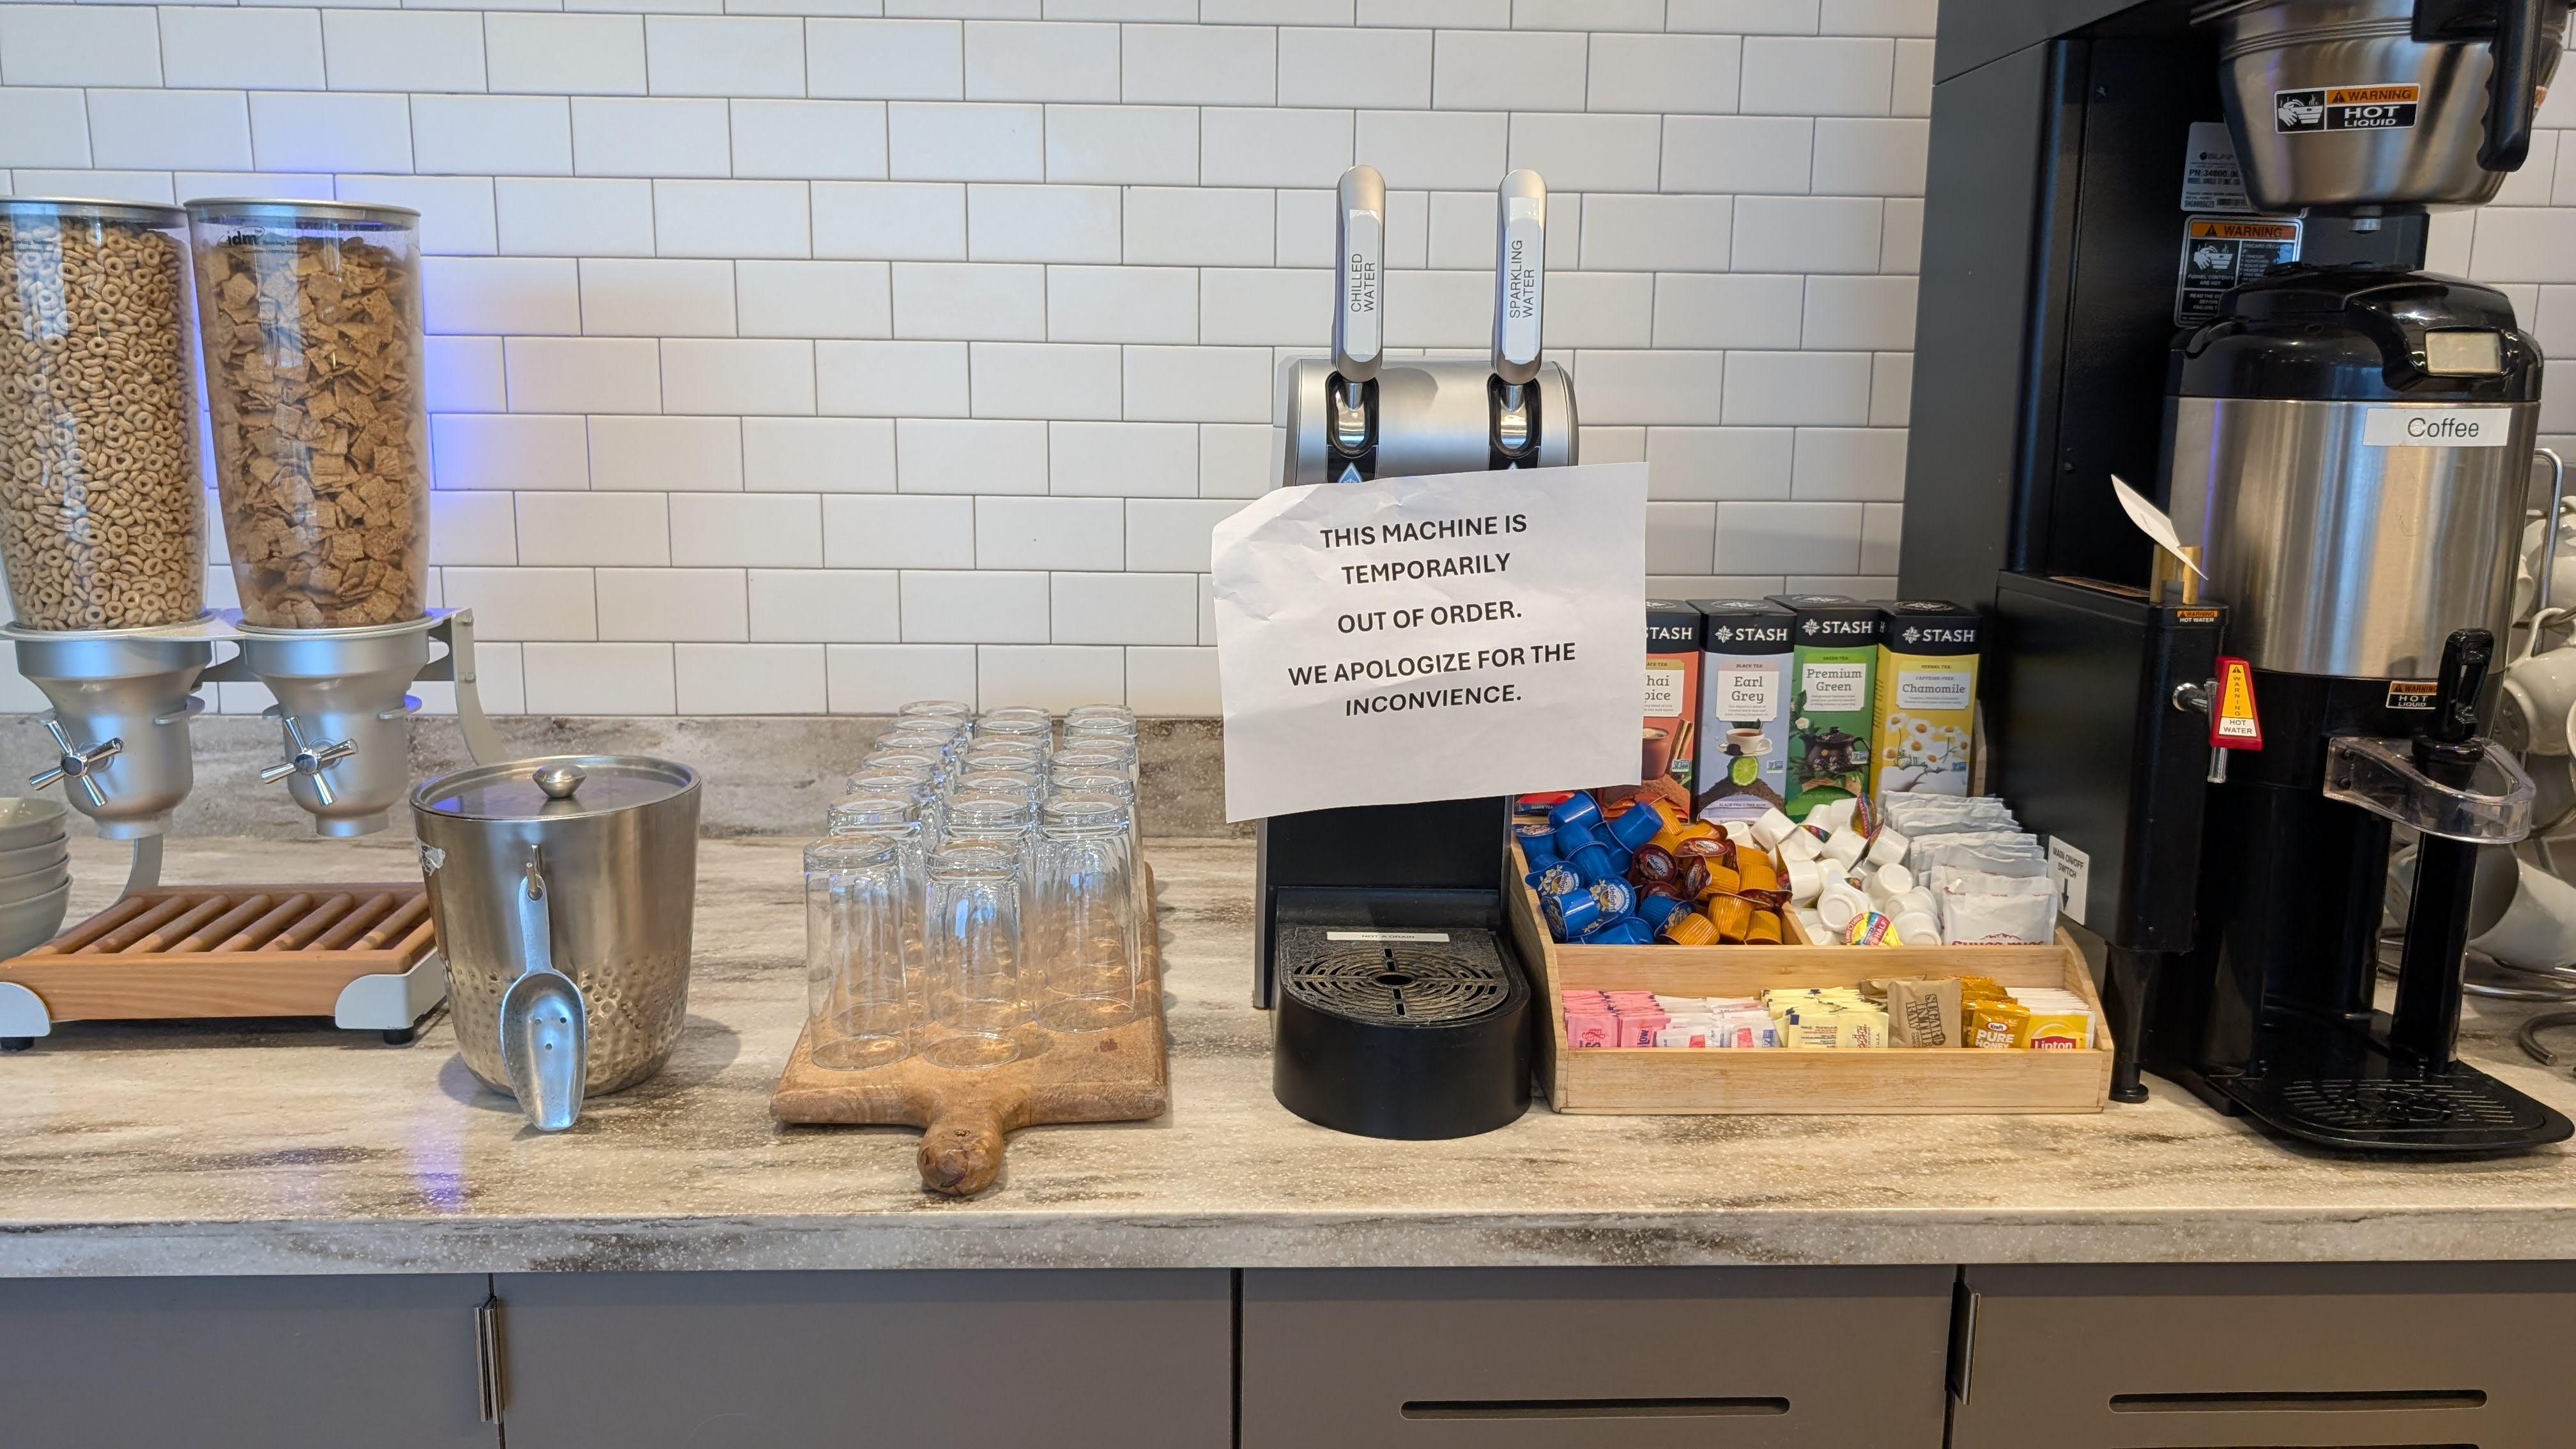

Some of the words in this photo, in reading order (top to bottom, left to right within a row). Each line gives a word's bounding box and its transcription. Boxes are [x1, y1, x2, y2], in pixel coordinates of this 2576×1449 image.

[2348, 89, 2412, 102] WARNING
[2344, 106, 2400, 119] HOT
[2344, 118, 2396, 127] LIQUID
[2224, 225, 2283, 238] WARNING
[1351, 253, 1363, 312] CHILLED
[1509, 240, 1523, 318] SPARKLING
[1363, 263, 1376, 312] WATER
[1522, 269, 1535, 318] WATER
[2407, 417, 2480, 438] Coffee
[1320, 525, 1376, 549] THIS
[1383, 516, 1498, 544] MACHINE
[1505, 514, 1528, 533] IS
[1342, 553, 1510, 585] TEMPORARILY
[1337, 611, 1386, 634] OUT
[1393, 609, 1424, 629] OF
[1430, 601, 1522, 626] ORDER.
[1735, 628, 1788, 641] STASH
[1821, 621, 1872, 634] STASH
[1922, 629, 1975, 642] STASH
[1288, 665, 1328, 687] WE
[1333, 652, 1471, 683] APOLOGIZE
[1478, 646, 1526, 669] FOR
[1531, 643, 1576, 664] THE
[1646, 675, 1670, 686] hai
[1806, 668, 1862, 678] Premium
[1733, 676, 1763, 687] Earl
[1816, 681, 1851, 691] Green
[1902, 683, 1965, 693] Chamomile
[2405, 684, 2438, 693] WARNING
[1345, 684, 1522, 716] INCONVIENCE.
[1731, 690, 1764, 704] Grey
[2232, 676, 2242, 716] WARNING
[2223, 726, 2253, 735] WATER
[1646, 854, 1667, 876] delight
[2053, 847, 2065, 861] MAIN
[2065, 854, 2084, 870] ON/OFF
[2057, 862, 2077, 879] SWITCH
[1873, 919, 1889, 939] HALF
[1906, 1001, 1919, 1029] RAW
[1916, 1003, 1928, 1018] IN
[1925, 994, 1942, 1037] SUGAR
[1919, 1018, 1933, 1048] THE
[1976, 1029, 2015, 1044] PURE
[1975, 1039, 2009, 1048] HONEY
[2034, 1040, 2073, 1048] Lipton
